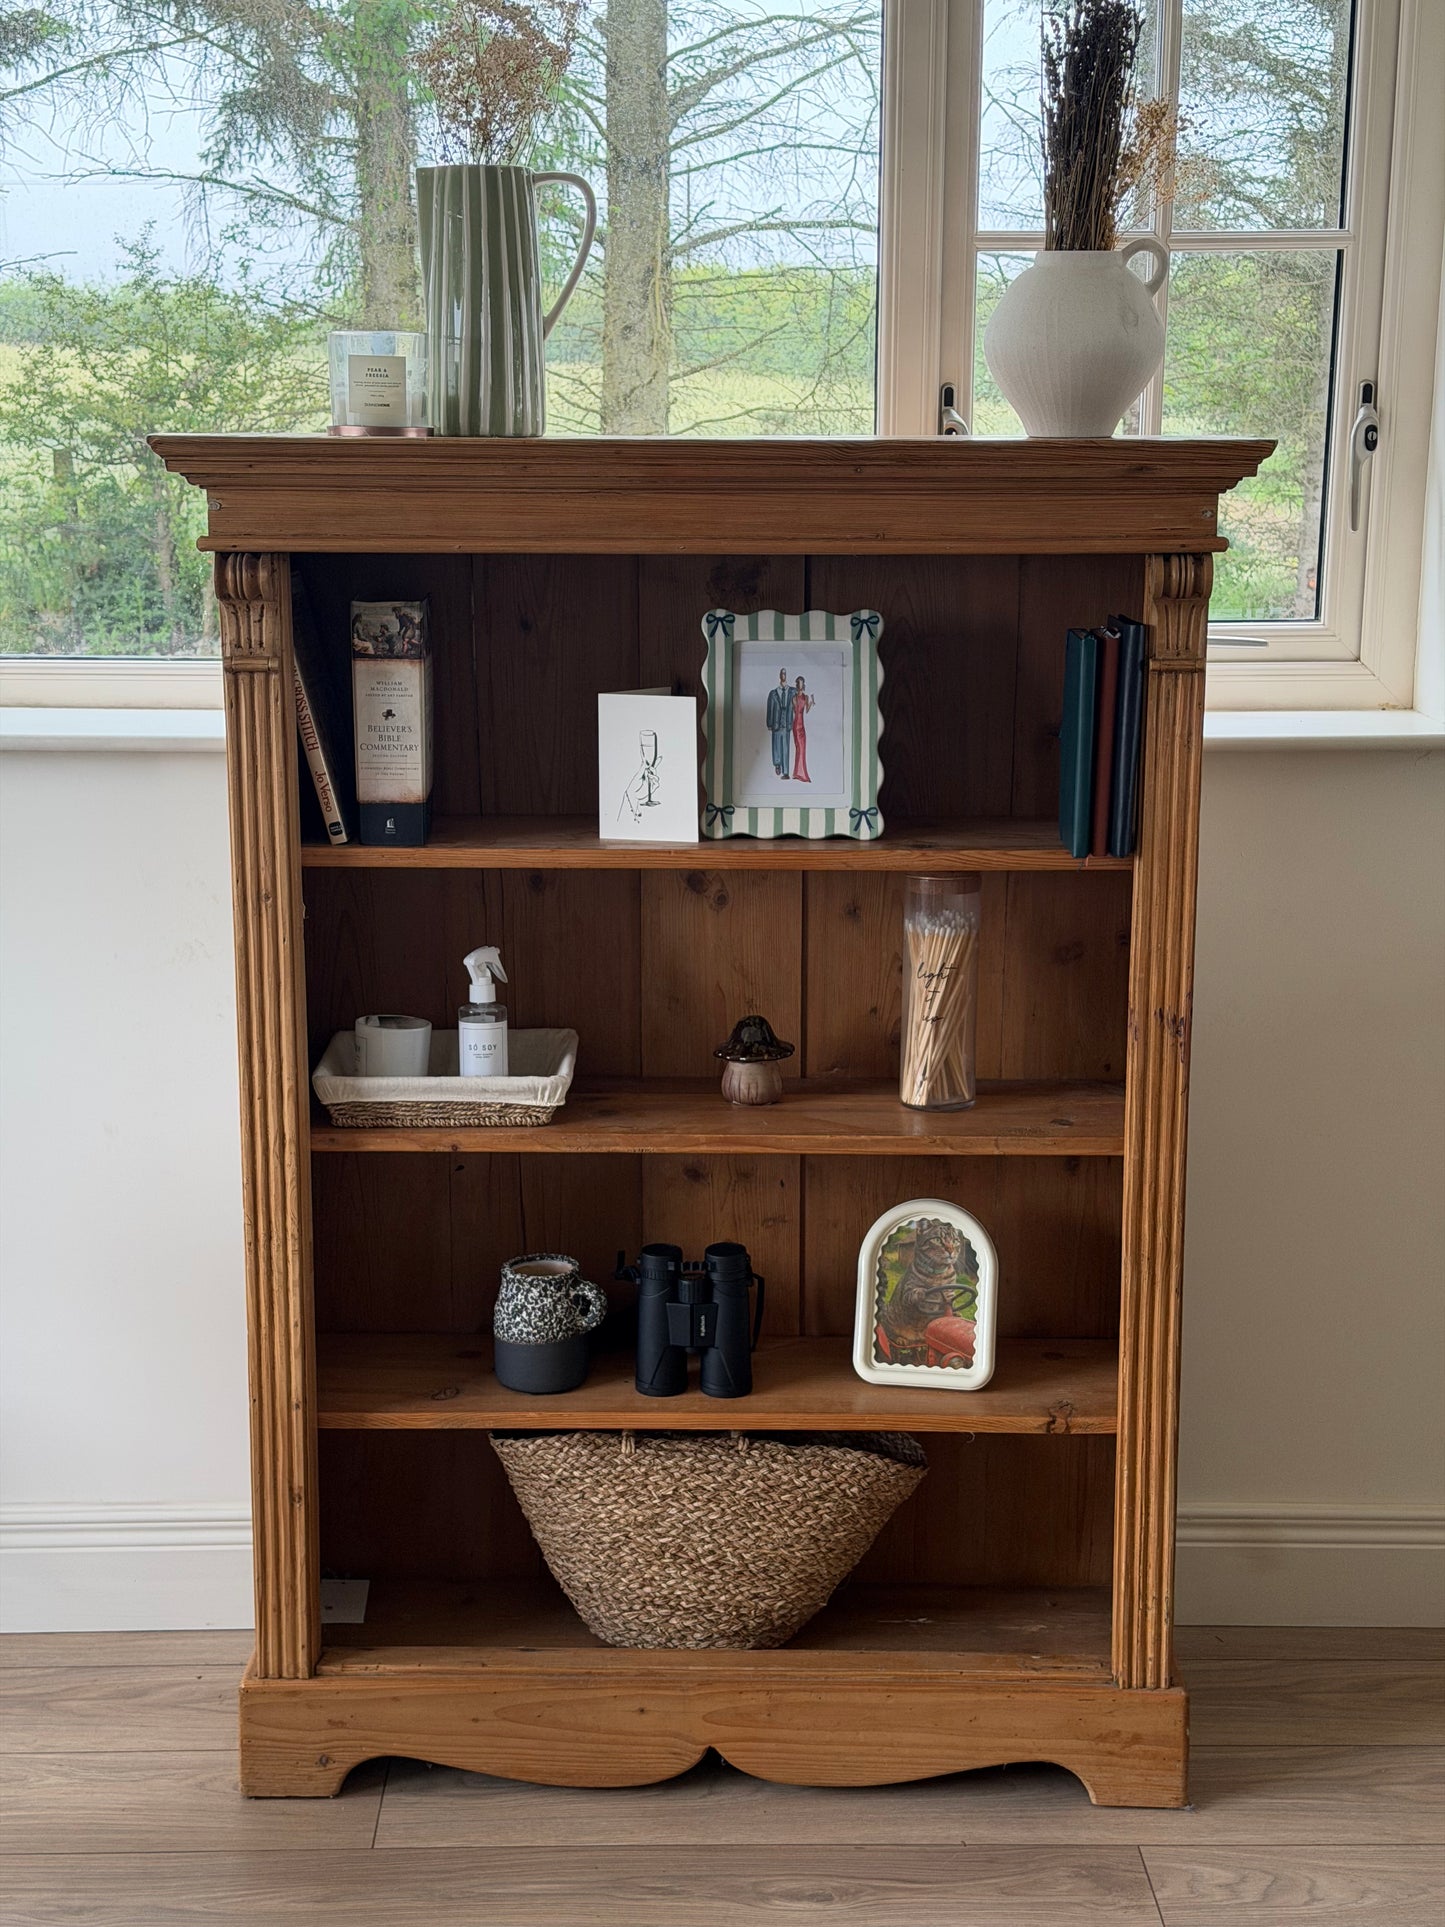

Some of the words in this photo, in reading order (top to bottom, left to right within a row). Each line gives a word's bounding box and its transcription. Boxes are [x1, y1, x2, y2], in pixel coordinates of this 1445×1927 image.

[294, 679, 309, 713] CROSS
[299, 713, 319, 752] STITCH
[378, 734, 401, 742] BIBLE
[359, 742, 419, 751] COMMENTARY
[314, 770, 327, 784] Jo
[320, 783, 333, 812] Verso
[916, 961, 959, 988] light
[925, 987, 940, 1009] it
[922, 1015, 944, 1024] up
[482, 1043, 497, 1051] SOY
